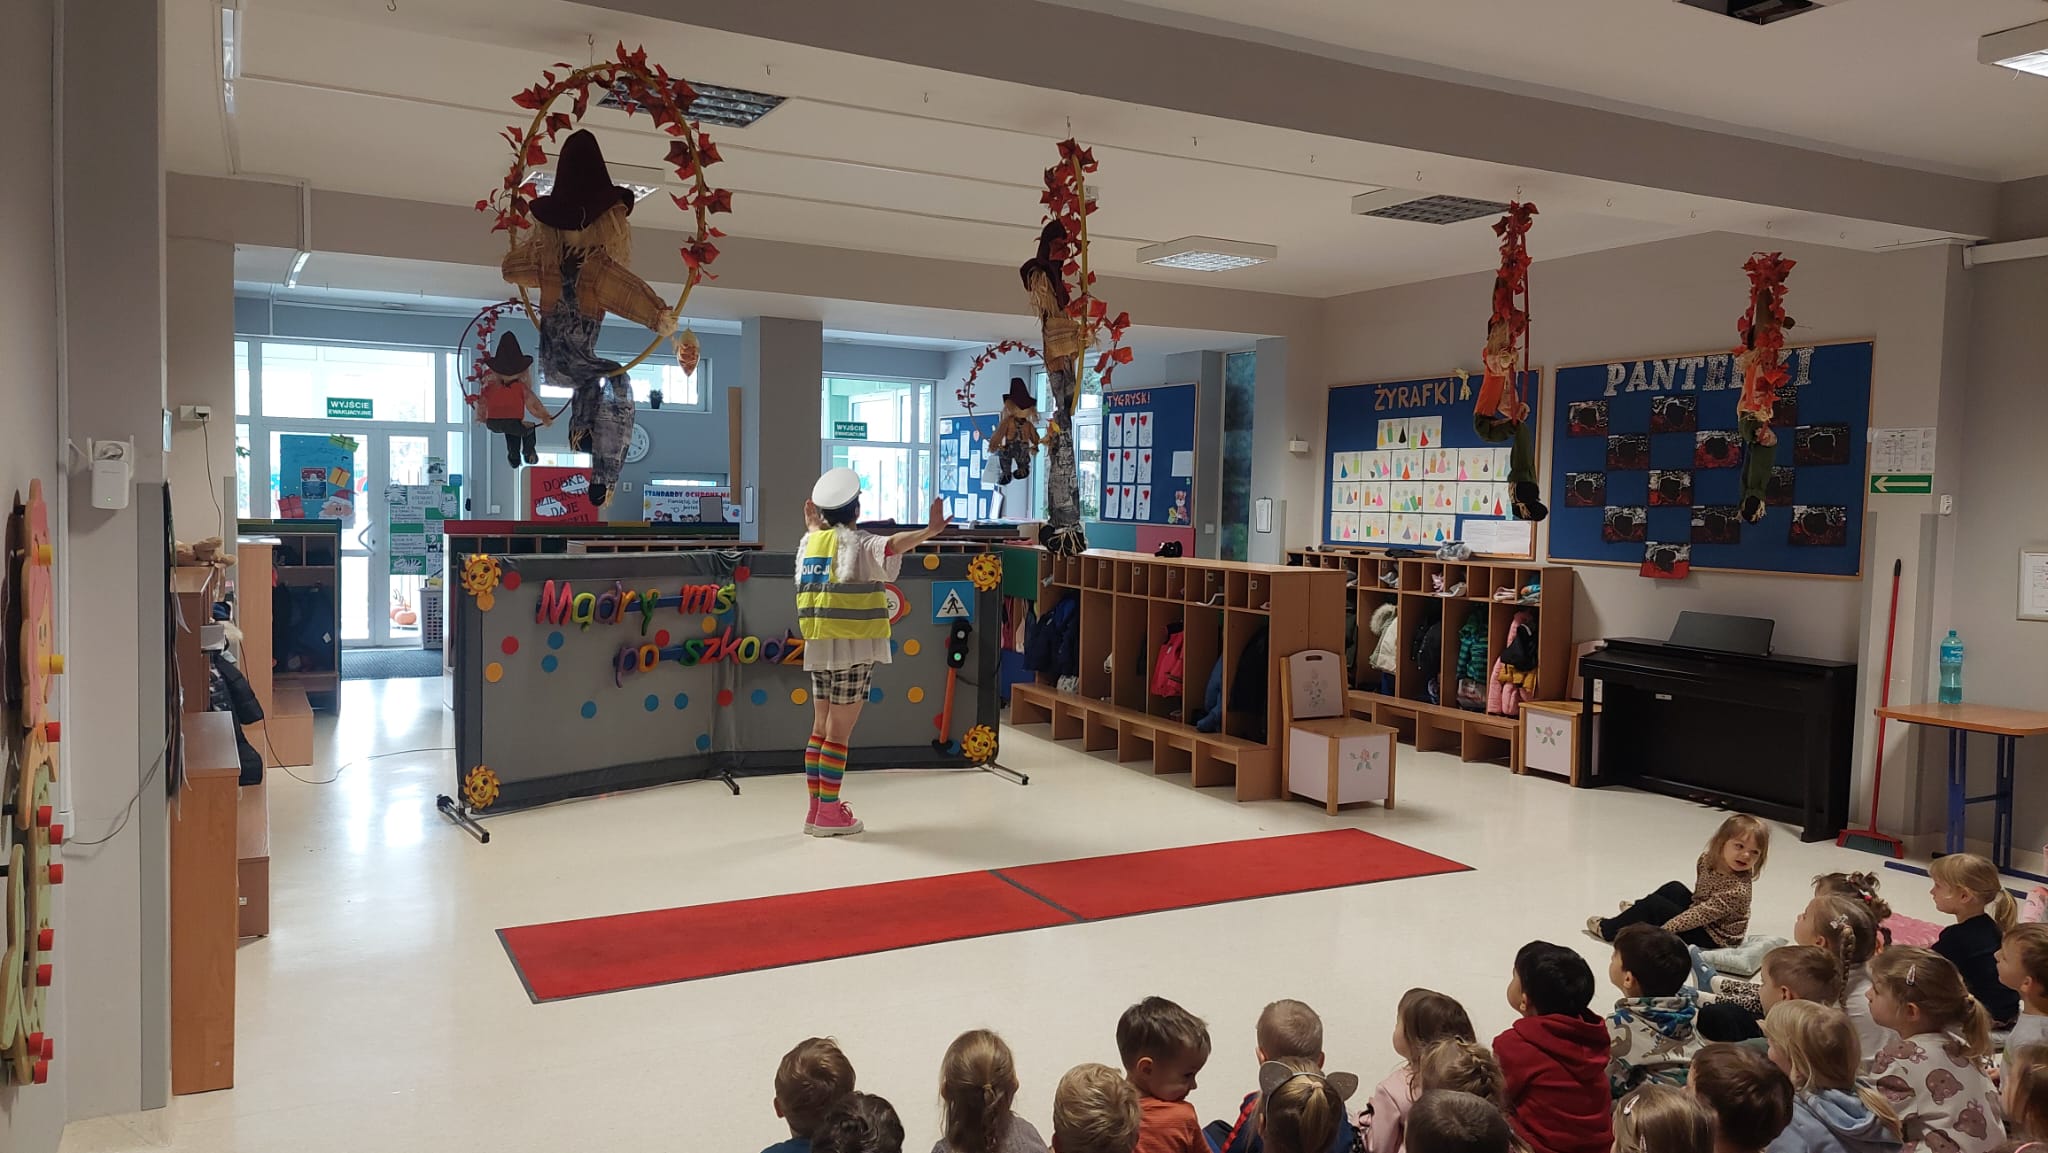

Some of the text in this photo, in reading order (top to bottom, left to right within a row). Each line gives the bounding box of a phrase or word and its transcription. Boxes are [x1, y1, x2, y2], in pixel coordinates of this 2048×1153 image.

[1603, 347, 1814, 396] PANTEI
[331, 400, 369, 409] WYJŚCIE
[836, 423, 865, 432] WYJŚCIE
[551, 502, 579, 518] DAJE
[535, 579, 736, 637] Mądry miś
[615, 625, 804, 688] po szkodz
